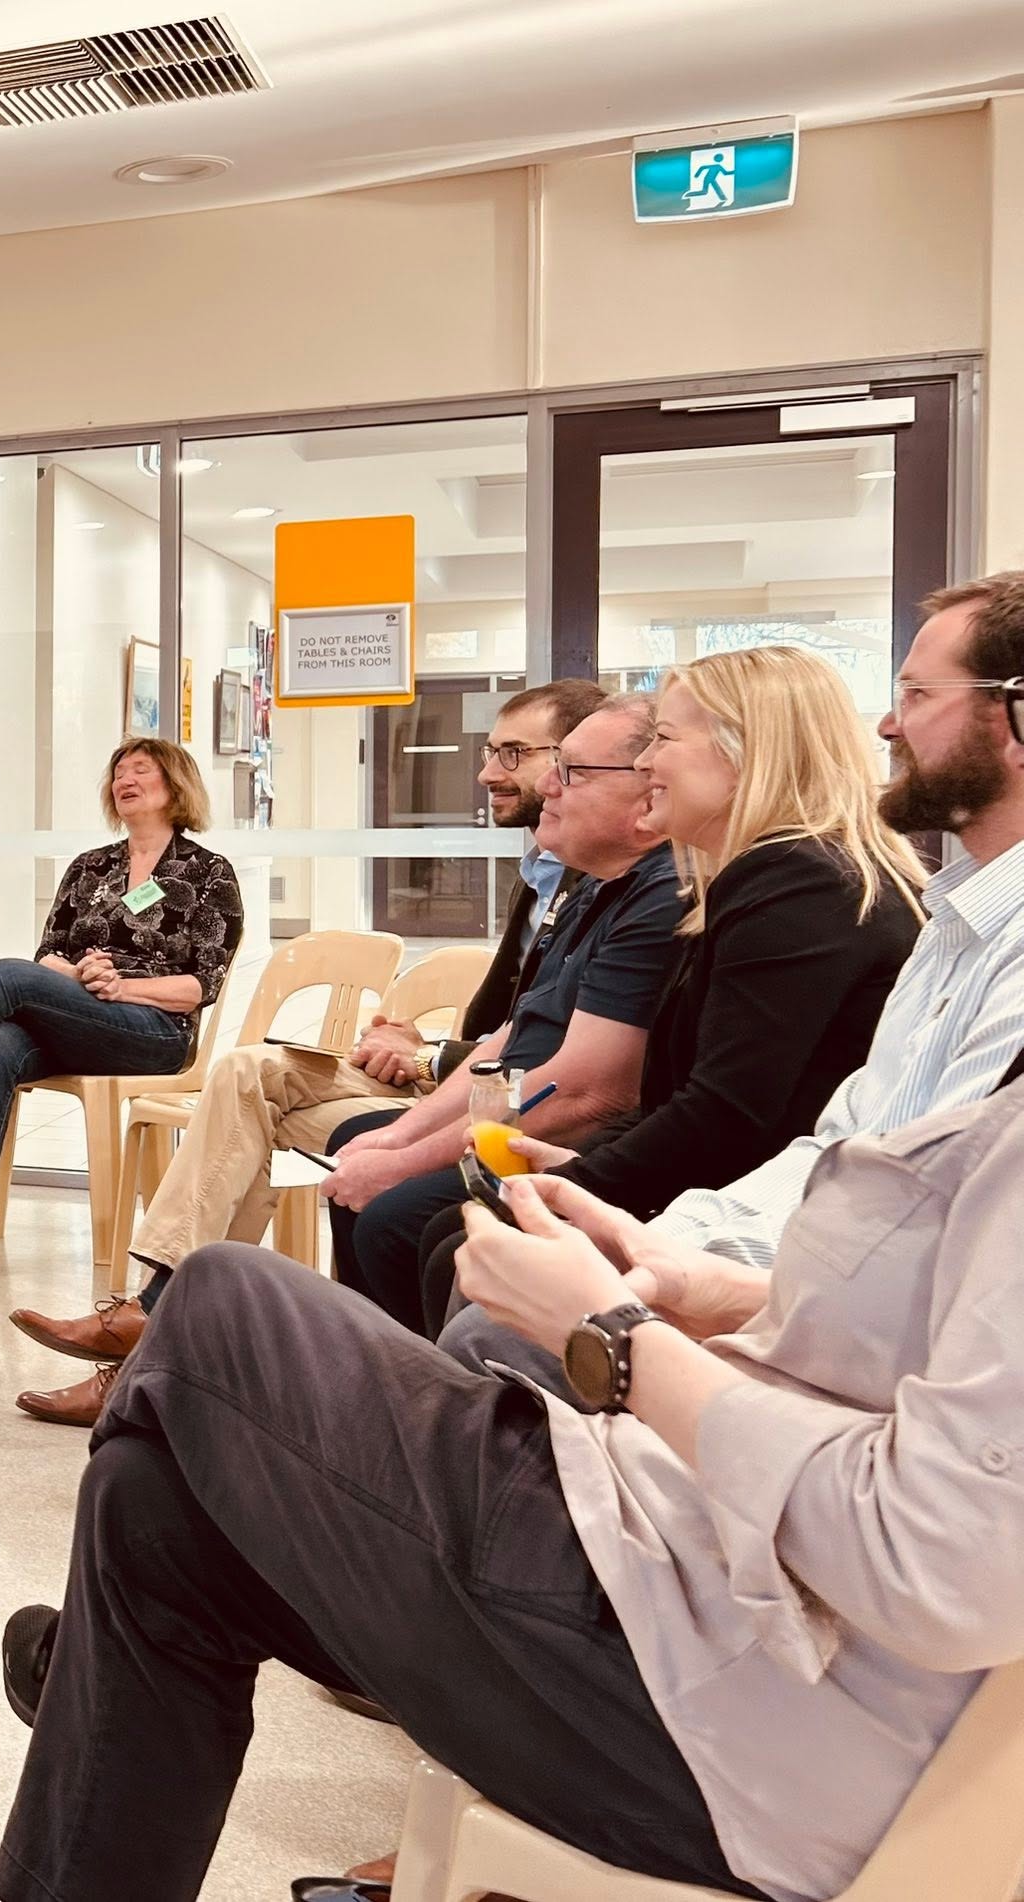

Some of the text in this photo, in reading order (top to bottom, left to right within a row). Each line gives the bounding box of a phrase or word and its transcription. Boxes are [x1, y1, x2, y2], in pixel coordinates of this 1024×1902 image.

[300, 634, 389, 646] DO NOT REMOVE
[297, 645, 392, 658] TABLES & CHAIRS
[297, 657, 391, 669] FROM THIS ROOM
